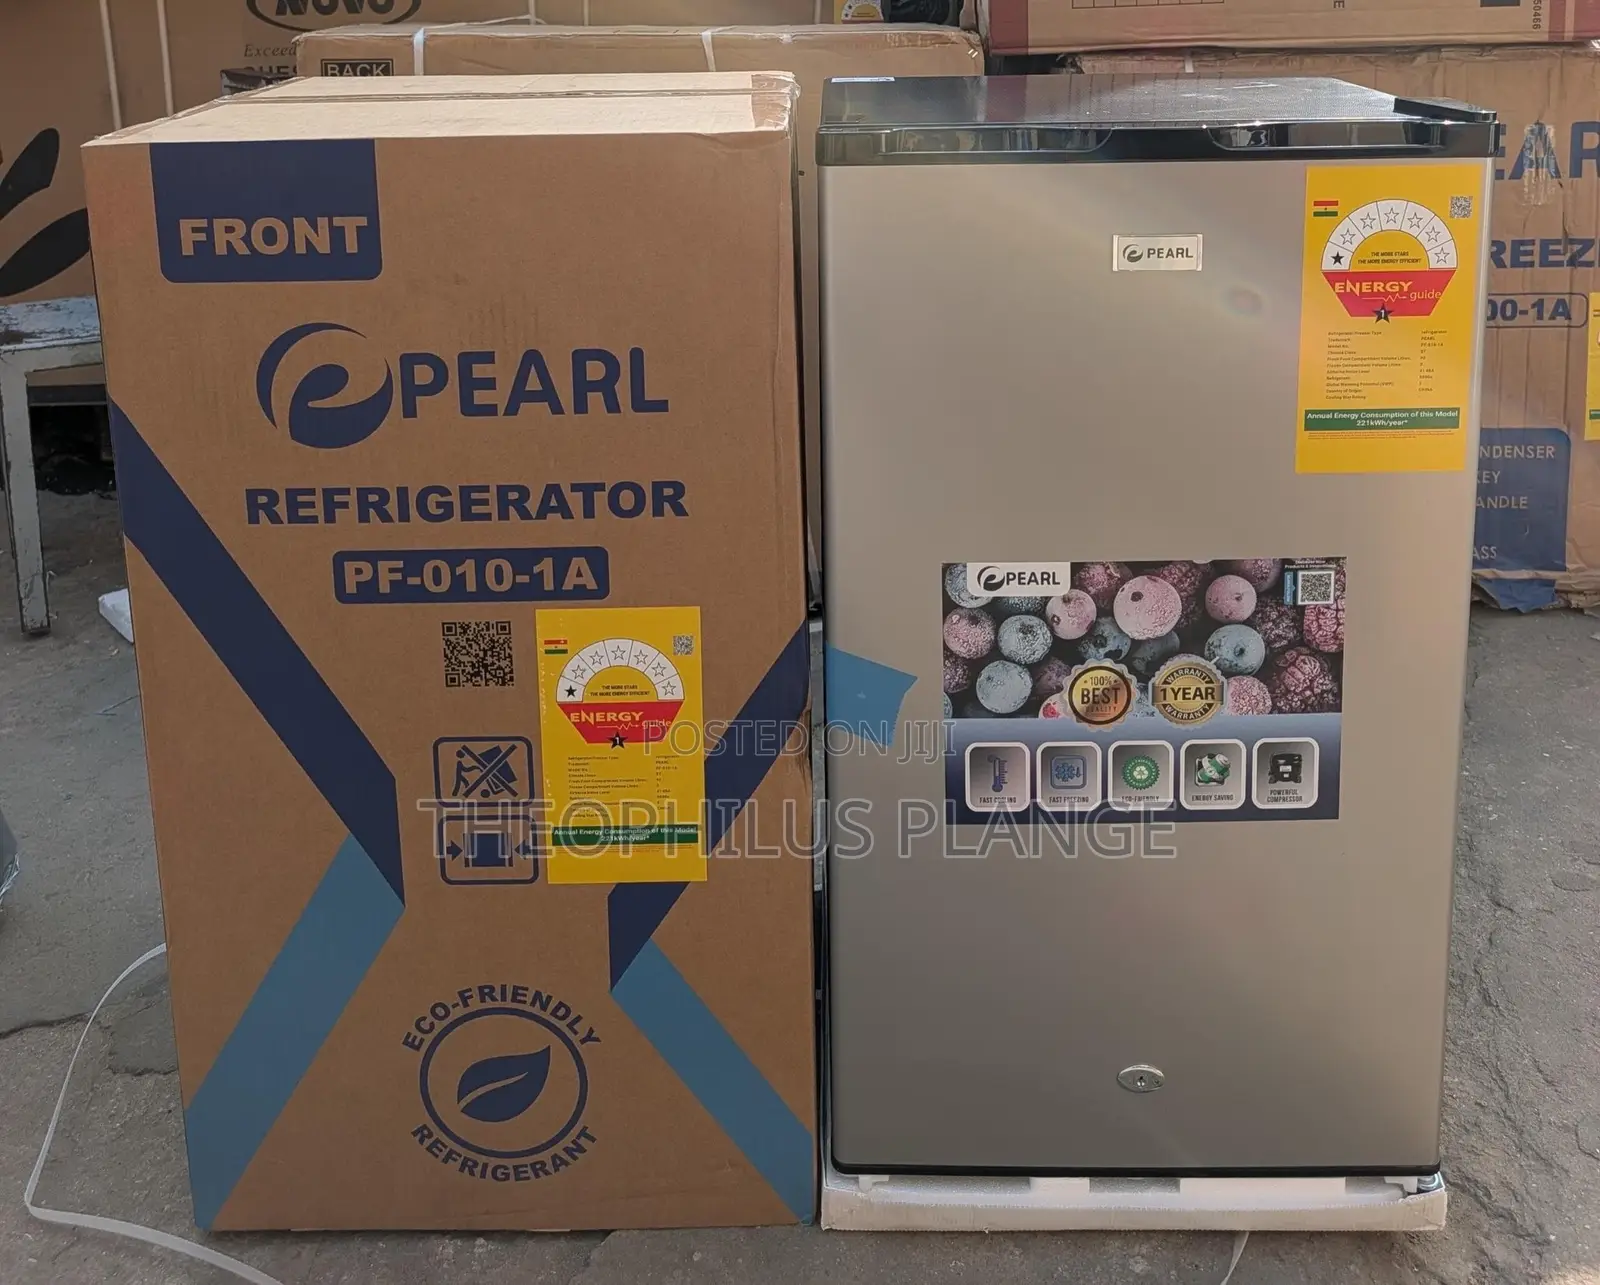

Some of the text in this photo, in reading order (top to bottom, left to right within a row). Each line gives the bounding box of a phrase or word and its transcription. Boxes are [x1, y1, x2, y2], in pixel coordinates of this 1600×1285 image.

[327, 63, 387, 76] BACK
[179, 216, 368, 257] FRONT
[1147, 247, 1194, 259] PEARL
[1334, 279, 1413, 297] ENERGY
[1410, 289, 1442, 301] guide
[1380, 309, 1385, 318] 1
[399, 347, 669, 419] PEARL
[1333, 412, 1359, 420] Energy
[1360, 411, 1409, 420] Consumption
[1435, 410, 1459, 418] Model
[1479, 445, 1555, 459] NDENSER
[245, 481, 689, 525] REFRIGERATOR
[343, 557, 599, 595] PF-010-1A
[1005, 571, 1061, 586] PEARL
[1090, 676, 1113, 687] 100%
[1166, 667, 1211, 684] WARRANTY
[1080, 687, 1121, 705] BEST
[1159, 686, 1216, 701] 1 YEAR
[570, 709, 644, 726] ENERGY
[1165, 704, 1210, 720] WARRANTY
[614, 736, 620, 745] 1
[979, 796, 993, 804] FAST
[1049, 796, 1063, 804] FAST
[579, 828, 602, 836] Energy
[402, 983, 602, 1052] ECO-FRIENDLY
[410, 1124, 598, 1183] REFRIGERANT
